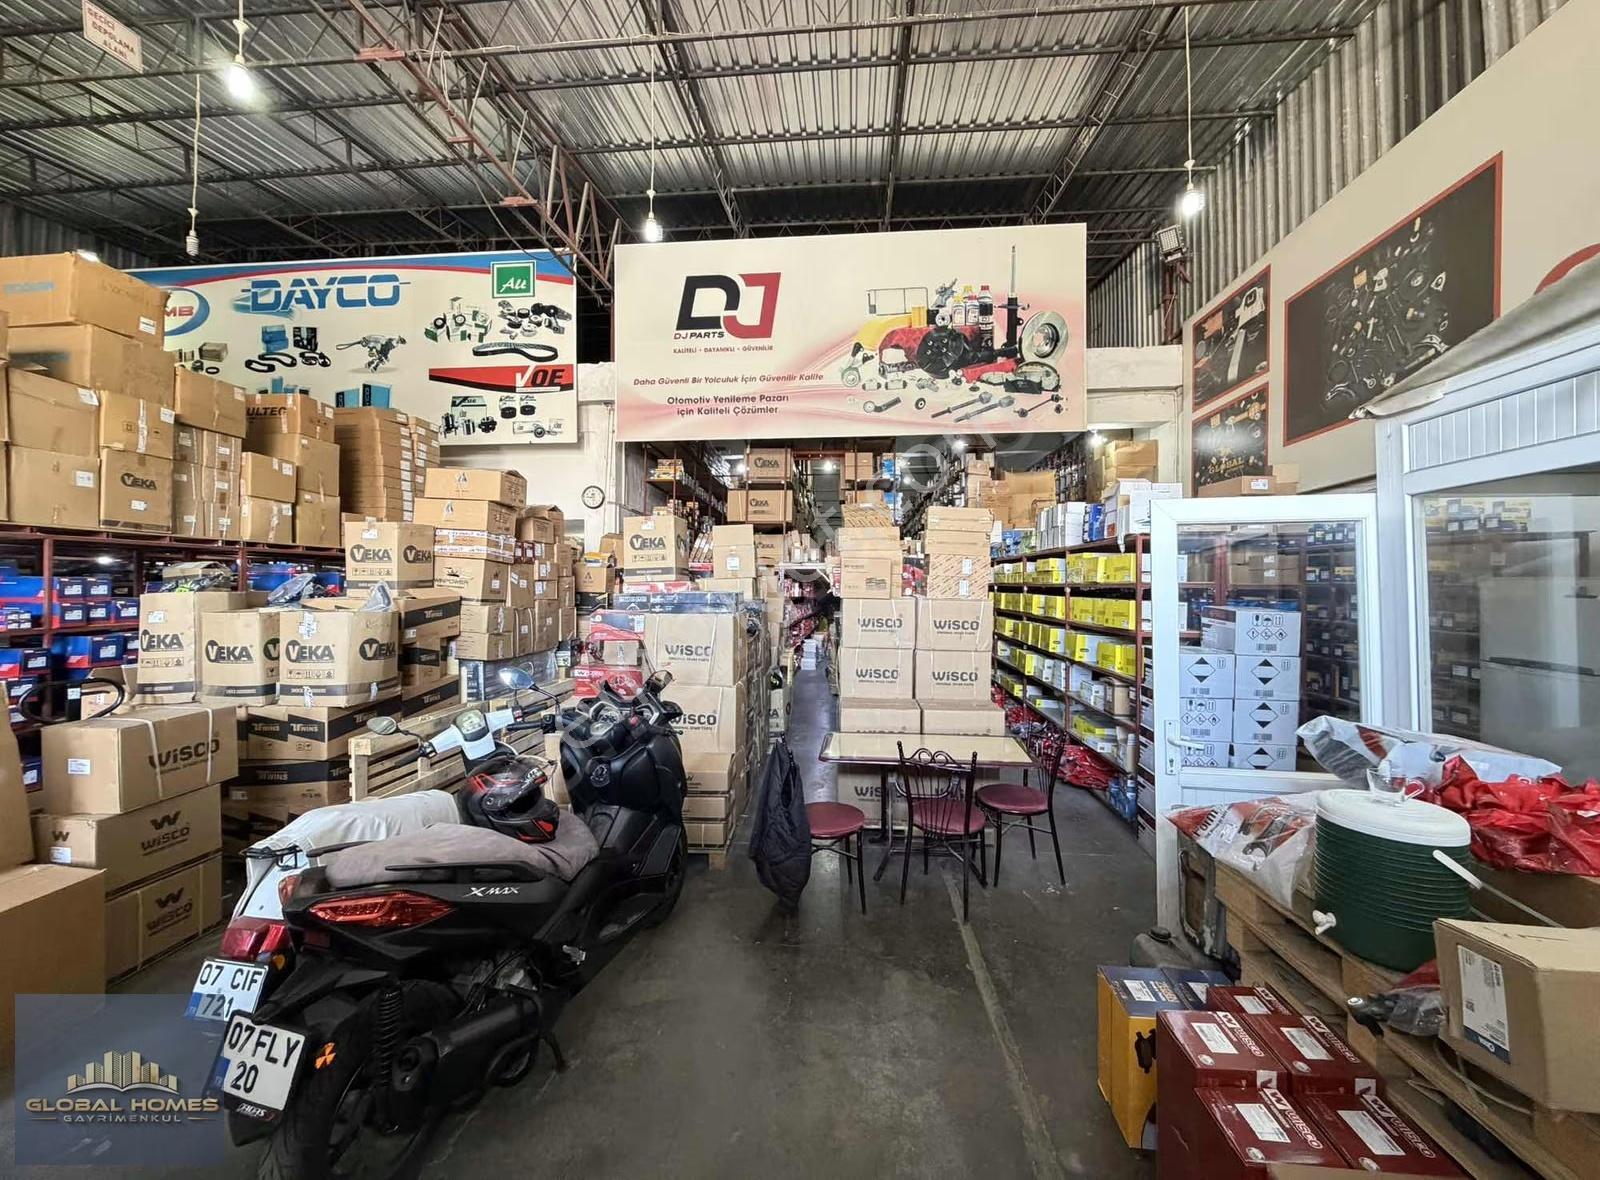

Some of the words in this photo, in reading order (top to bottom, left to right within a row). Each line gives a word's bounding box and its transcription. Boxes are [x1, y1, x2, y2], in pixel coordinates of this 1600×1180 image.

[250, 274, 401, 312] DAYCO
[676, 272, 781, 339] DJ
[674, 332, 688, 340] DJ
[689, 331, 725, 339] PARTS
[516, 365, 565, 388] VOE
[633, 378, 656, 386] Daha
[658, 377, 690, 385] Güvenli
[692, 376, 703, 384] Bir
[704, 376, 739, 384] Yolculuk
[741, 374, 757, 385] İçin
[759, 374, 797, 382] Güvenilir
[799, 373, 824, 381] Kalite
[667, 396, 711, 405] Otomotiv
[713, 395, 757, 404] Yenileme
[759, 394, 789, 403] Pazarı
[677, 407, 695, 418] için
[697, 407, 730, 416] Kaliteli
[733, 405, 778, 416] Çözümler
[120, 472, 157, 490] VEKA
[350, 544, 392, 562] VEKA
[630, 534, 667, 550] VEKA
[403, 545, 432, 563] VEKA
[140, 629, 184, 652] VEKA
[206, 640, 255, 663] VEKA
[286, 639, 335, 664] VEKA
[200, 963, 224, 986] 07
[230, 967, 263, 992] CIF
[202, 994, 234, 1019] 721
[228, 1021, 256, 1053] 07
[252, 1030, 301, 1068] FLY
[230, 1060, 259, 1094] 20
